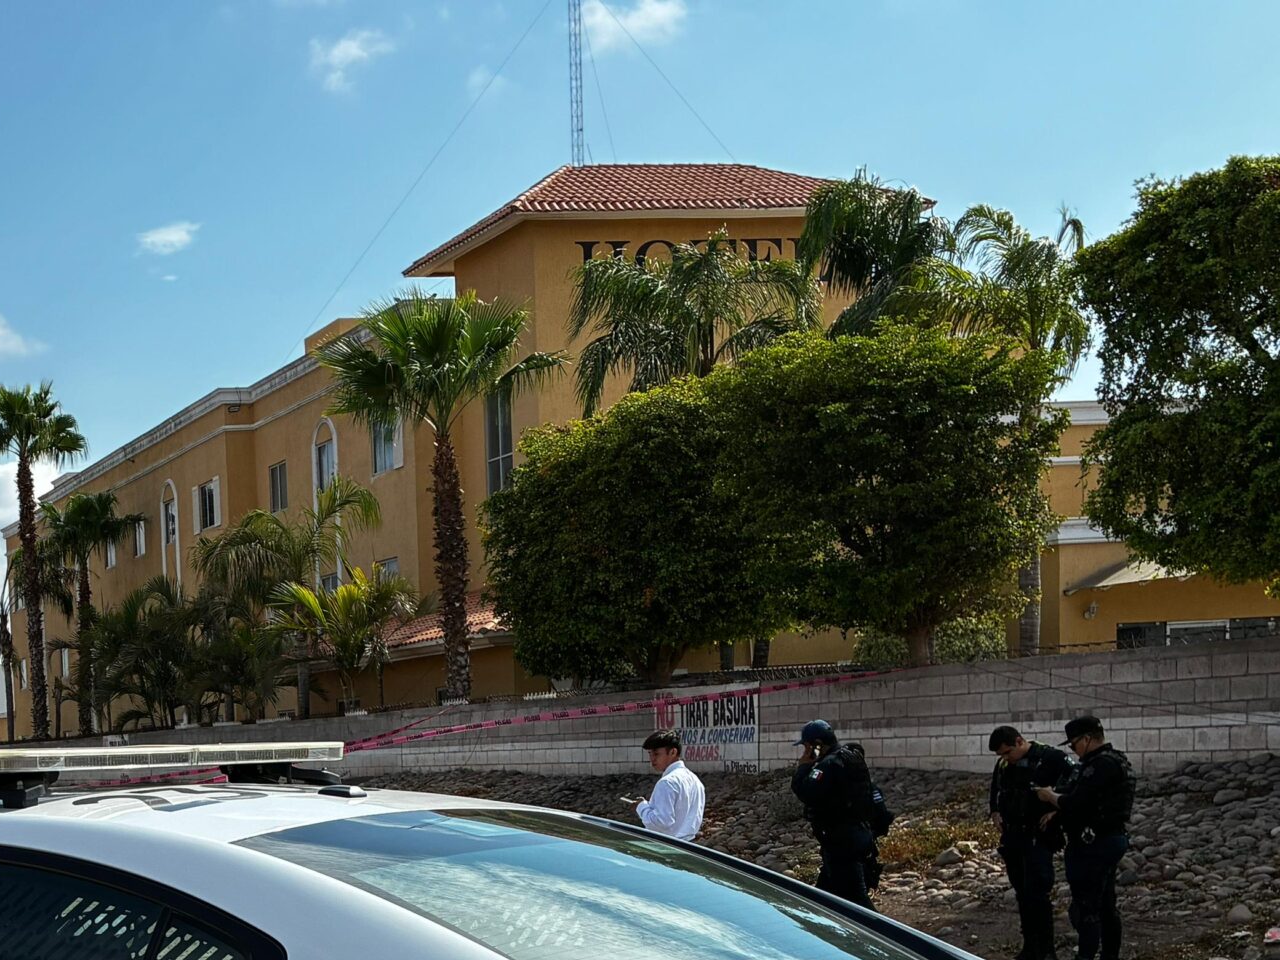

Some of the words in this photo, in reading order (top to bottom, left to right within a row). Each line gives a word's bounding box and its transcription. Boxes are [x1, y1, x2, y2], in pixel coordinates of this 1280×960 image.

[656, 692, 675, 729] NO
[680, 701, 708, 727] TIRAR
[713, 694, 755, 727] BASURA
[700, 729, 706, 744] A
[707, 726, 755, 744] CONSERVAR
